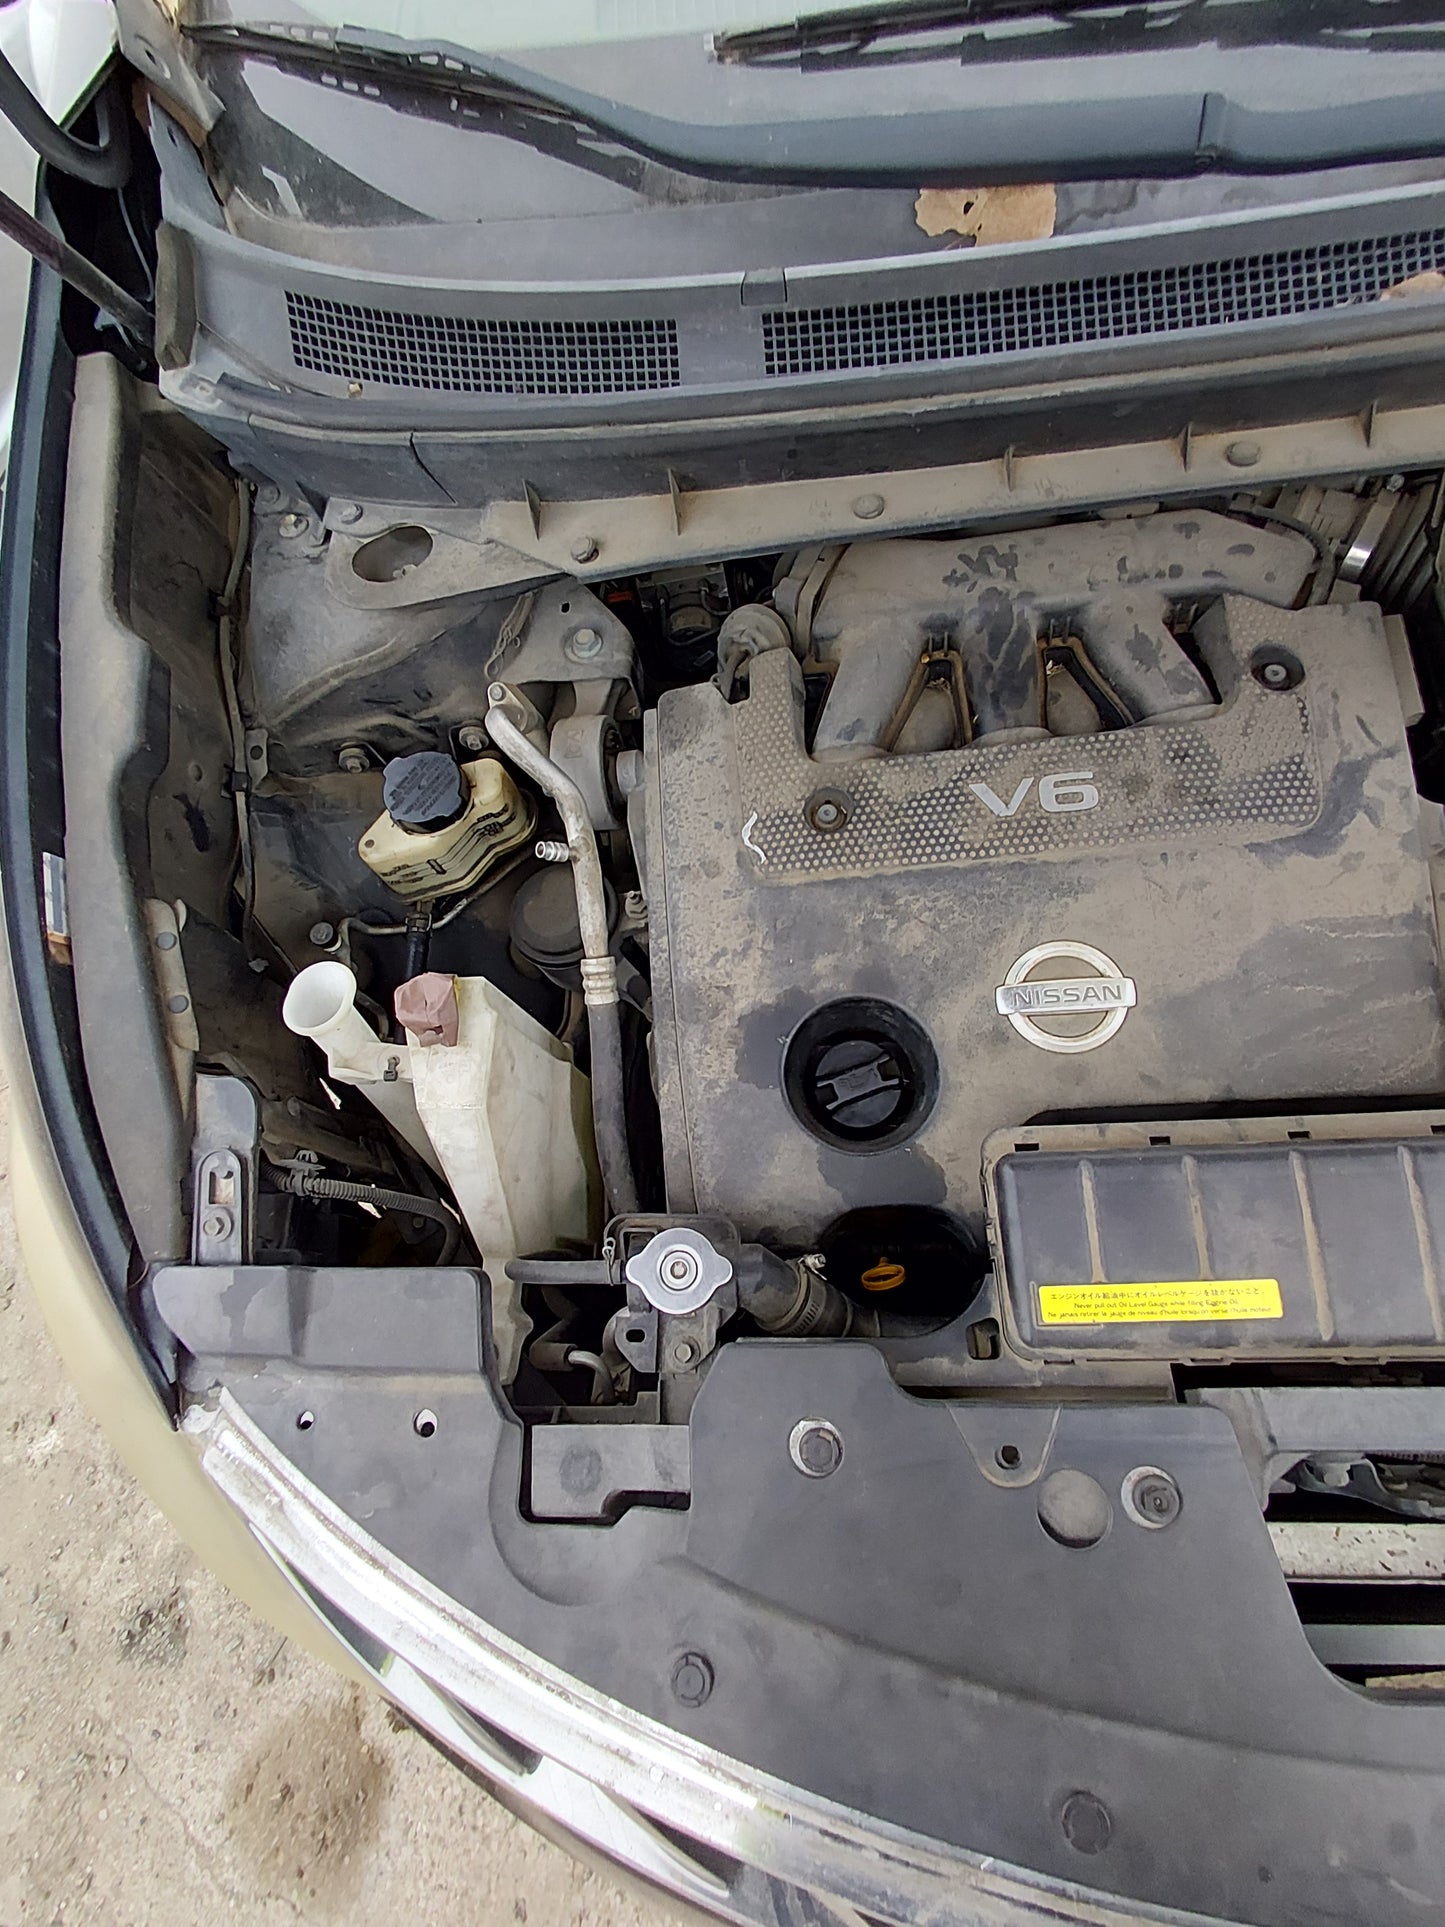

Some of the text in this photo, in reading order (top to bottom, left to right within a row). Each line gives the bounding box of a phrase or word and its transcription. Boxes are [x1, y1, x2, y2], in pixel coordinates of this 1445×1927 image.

[969, 771, 1098, 816] V6
[1012, 984, 1122, 1007] NISSAN
[1094, 1302, 1105, 1310] pull
[1148, 1300, 1168, 1308] Gauge
[1110, 1310, 1127, 1318] jauge
